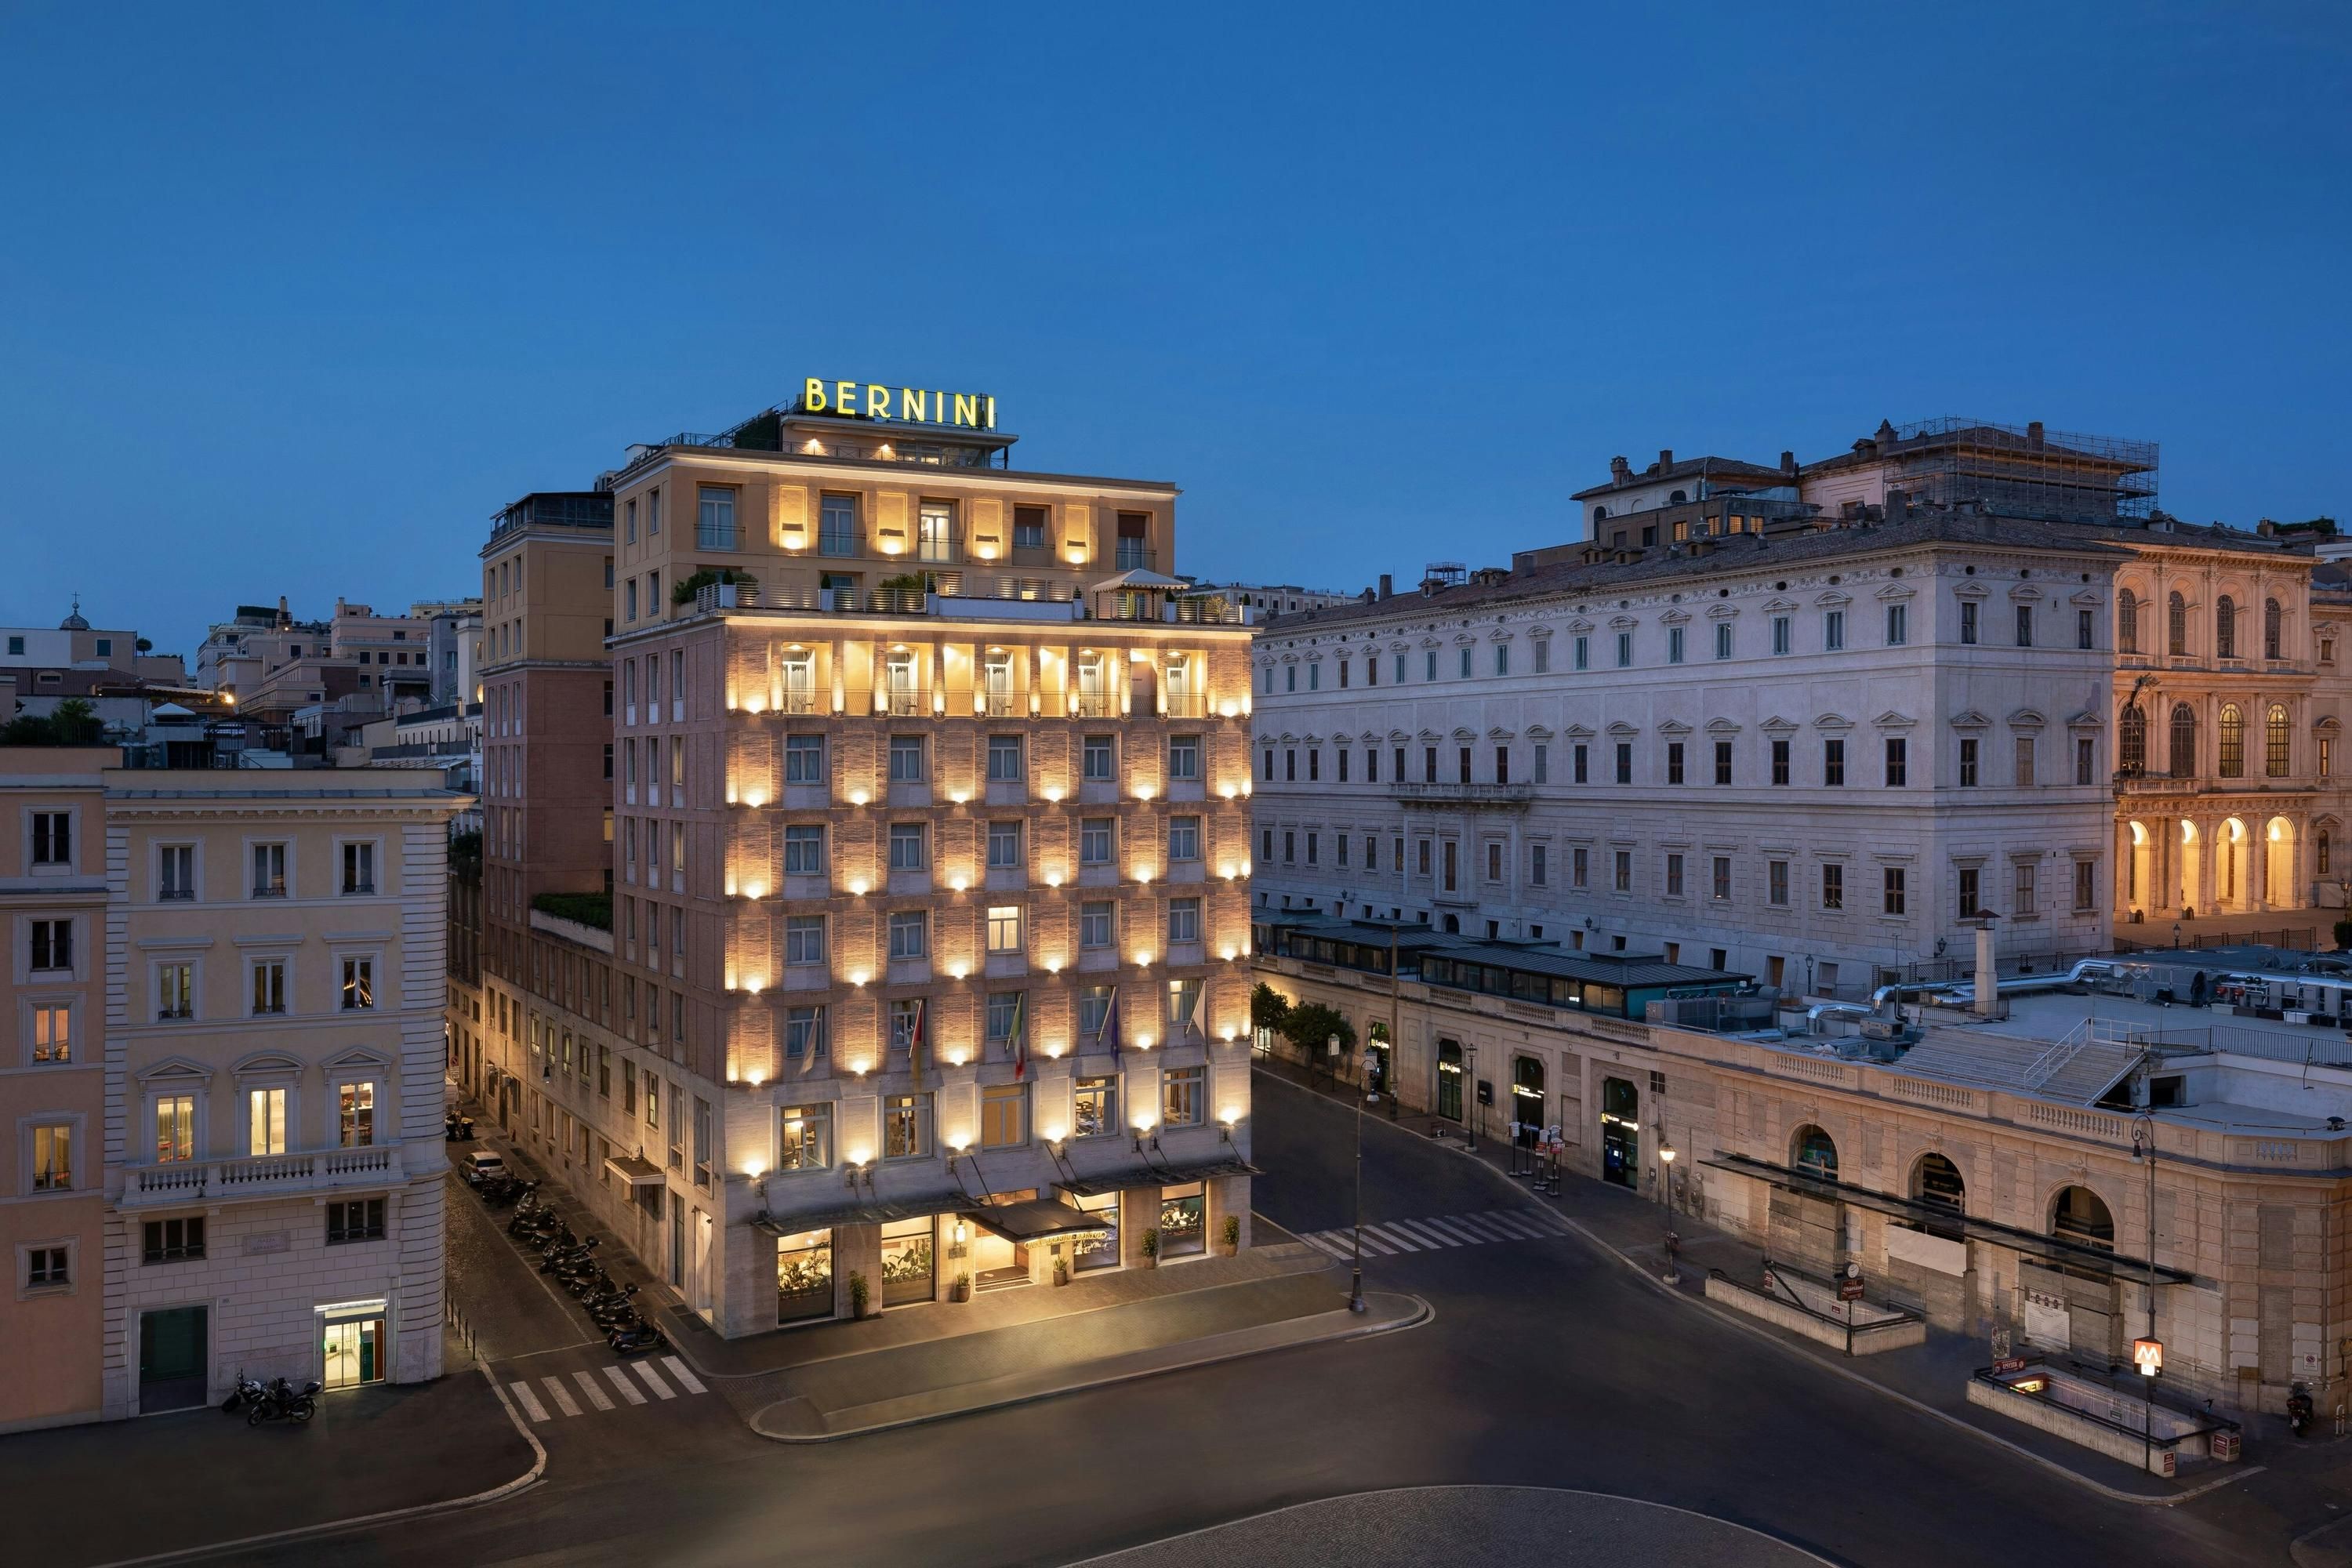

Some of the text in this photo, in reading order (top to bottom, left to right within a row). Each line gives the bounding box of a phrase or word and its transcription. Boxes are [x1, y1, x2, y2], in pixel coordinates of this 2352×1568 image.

[805, 377, 995, 428] BERNINI
[2136, 1345, 2160, 1362] M
[2002, 1361, 2018, 1370] USCITA
